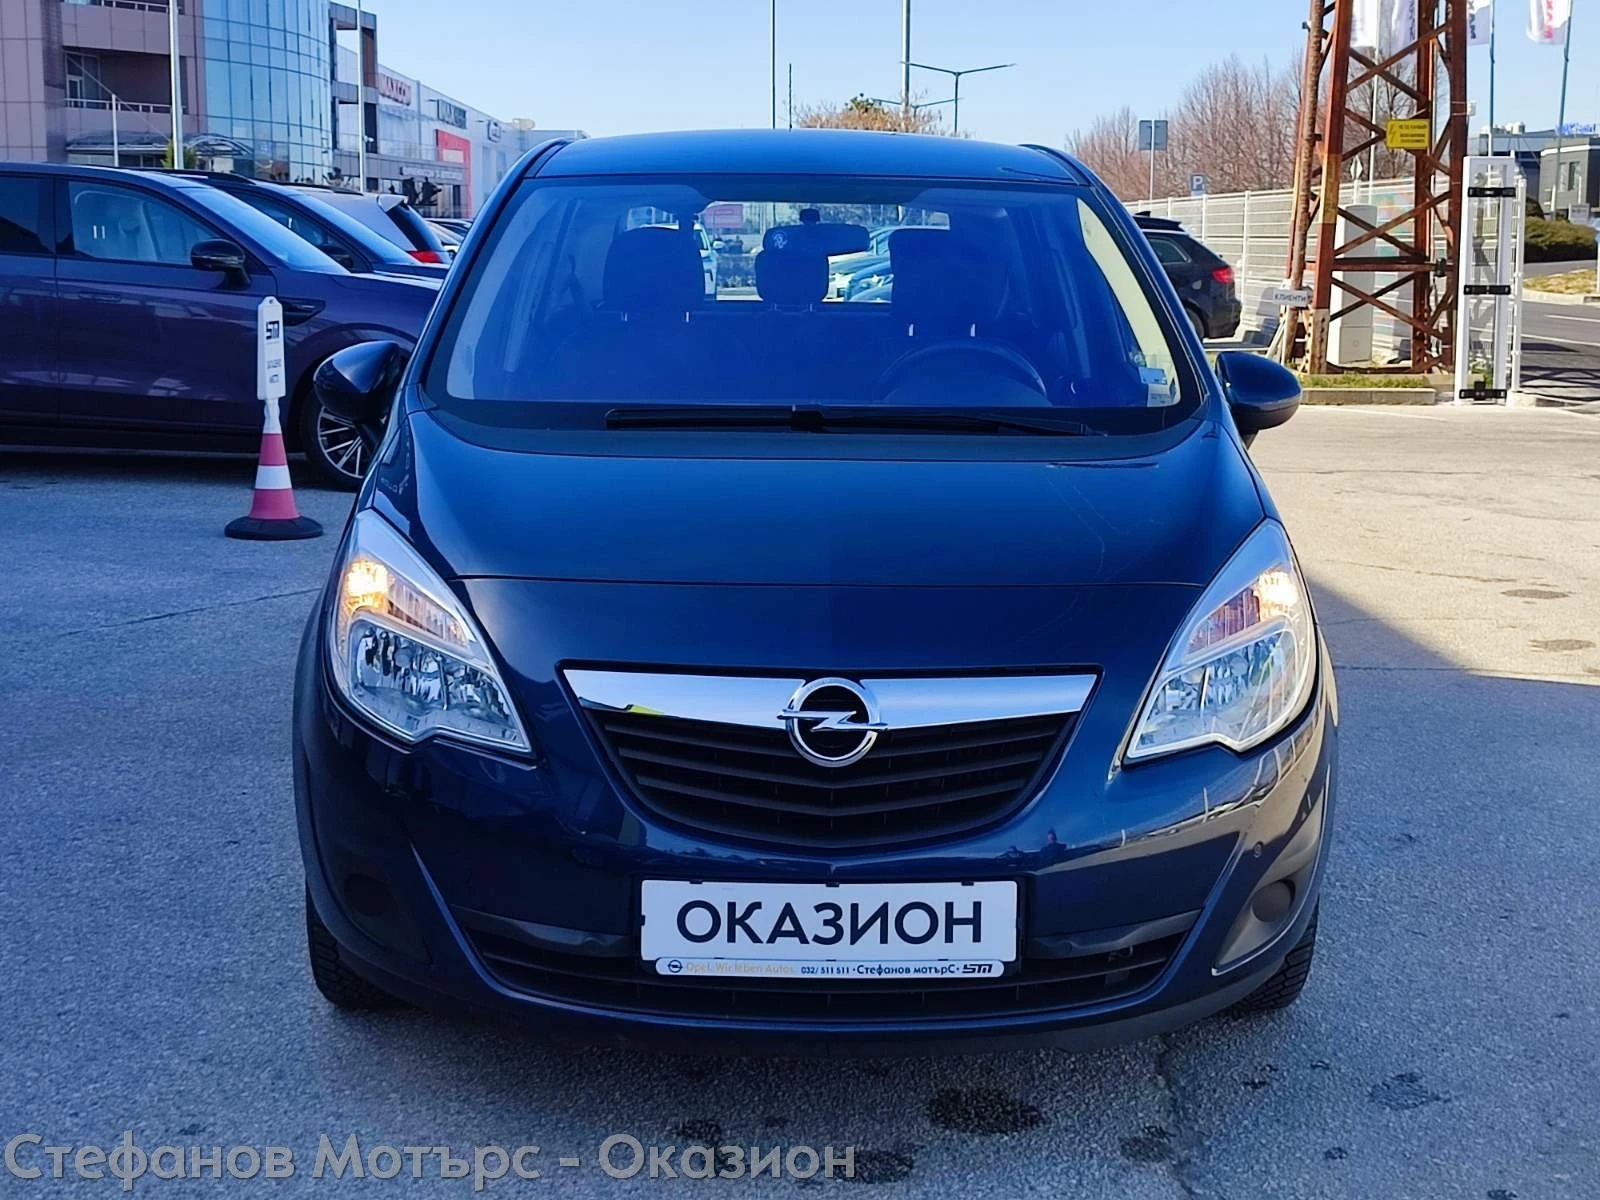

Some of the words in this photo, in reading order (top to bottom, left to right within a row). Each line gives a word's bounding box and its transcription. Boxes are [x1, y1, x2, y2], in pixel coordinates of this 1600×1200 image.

[676, 900, 982, 945] ОКАЗИОН
[820, 966, 834, 975] 511
[836, 966, 850, 975] 511
